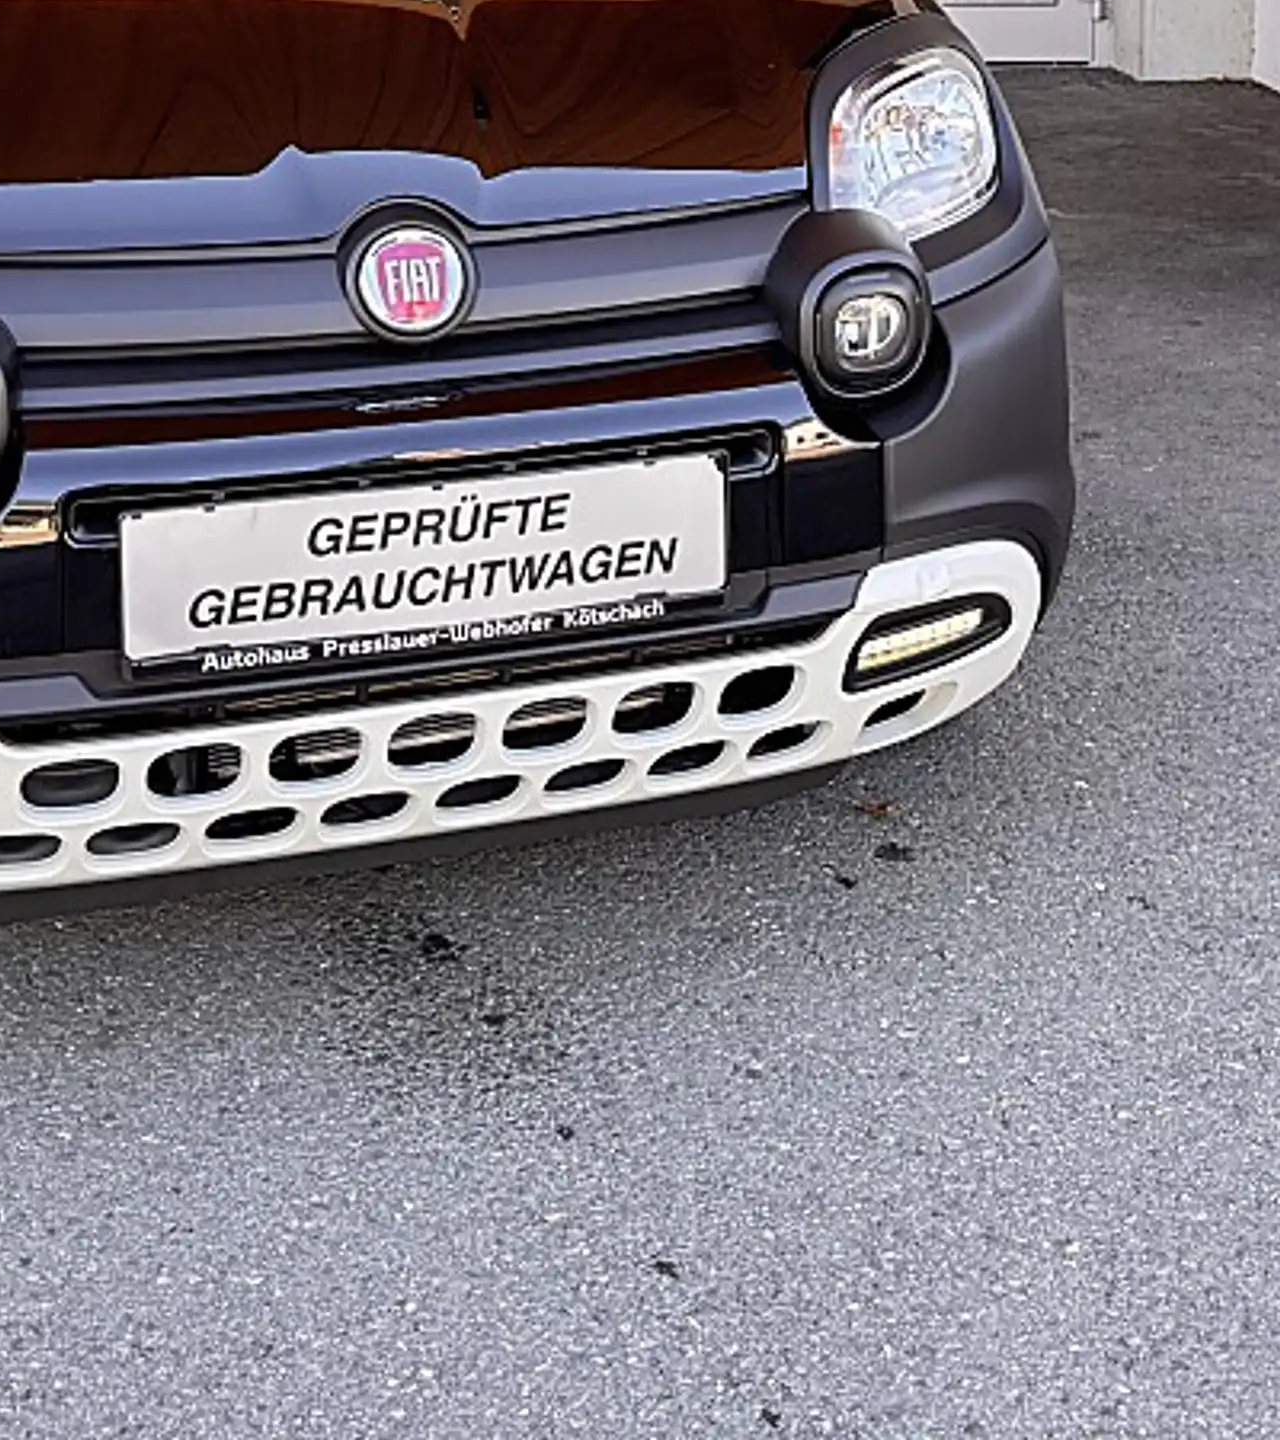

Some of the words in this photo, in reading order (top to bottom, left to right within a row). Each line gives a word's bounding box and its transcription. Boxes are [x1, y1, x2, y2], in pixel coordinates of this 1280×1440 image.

[384, 256, 441, 306] FIAT
[307, 493, 571, 558] GEPRÜFTE
[188, 537, 678, 629] GEBRAUCHTWAGEN
[201, 644, 310, 674] Autohaus
[322, 615, 555, 658] Presslauer-Webhofer
[563, 598, 665, 629] Kötschach
